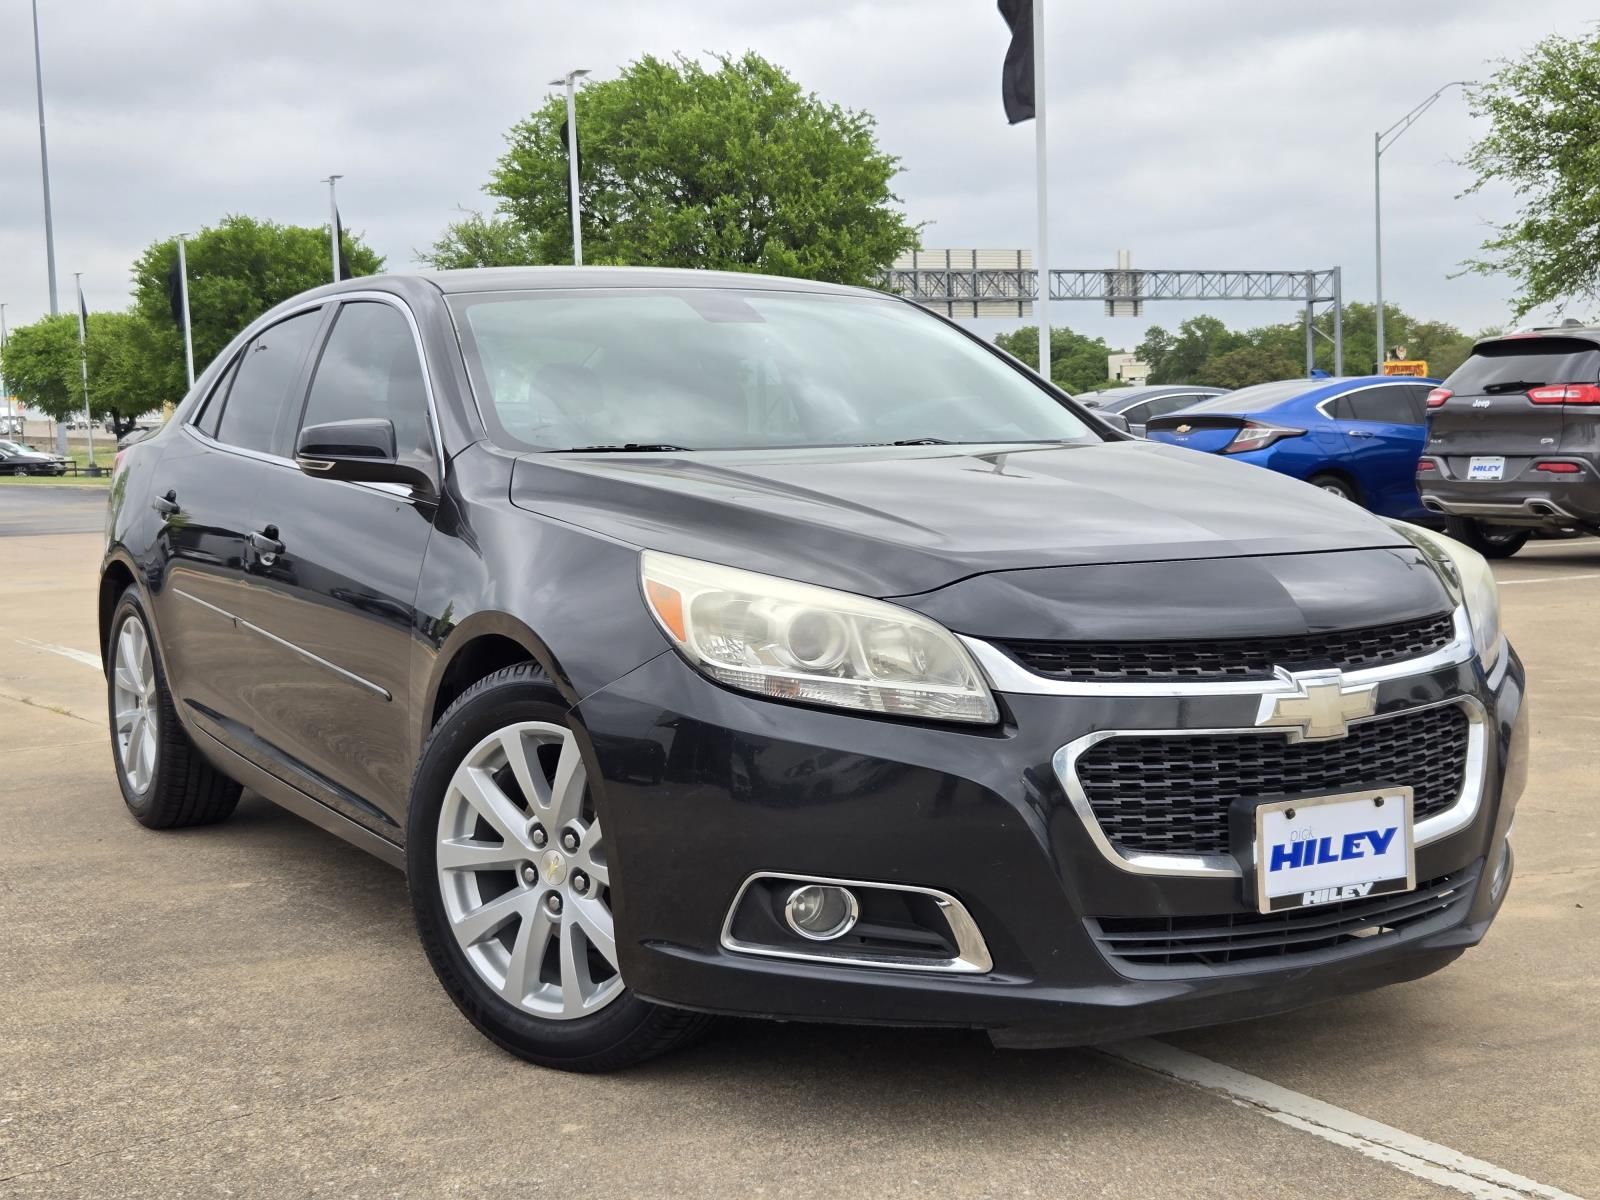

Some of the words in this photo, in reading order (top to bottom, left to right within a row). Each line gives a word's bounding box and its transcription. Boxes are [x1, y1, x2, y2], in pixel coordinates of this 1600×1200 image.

[1472, 399, 1490, 408] Jeep
[1270, 827, 1398, 872] HILEY
[1302, 881, 1375, 906] HILEY
